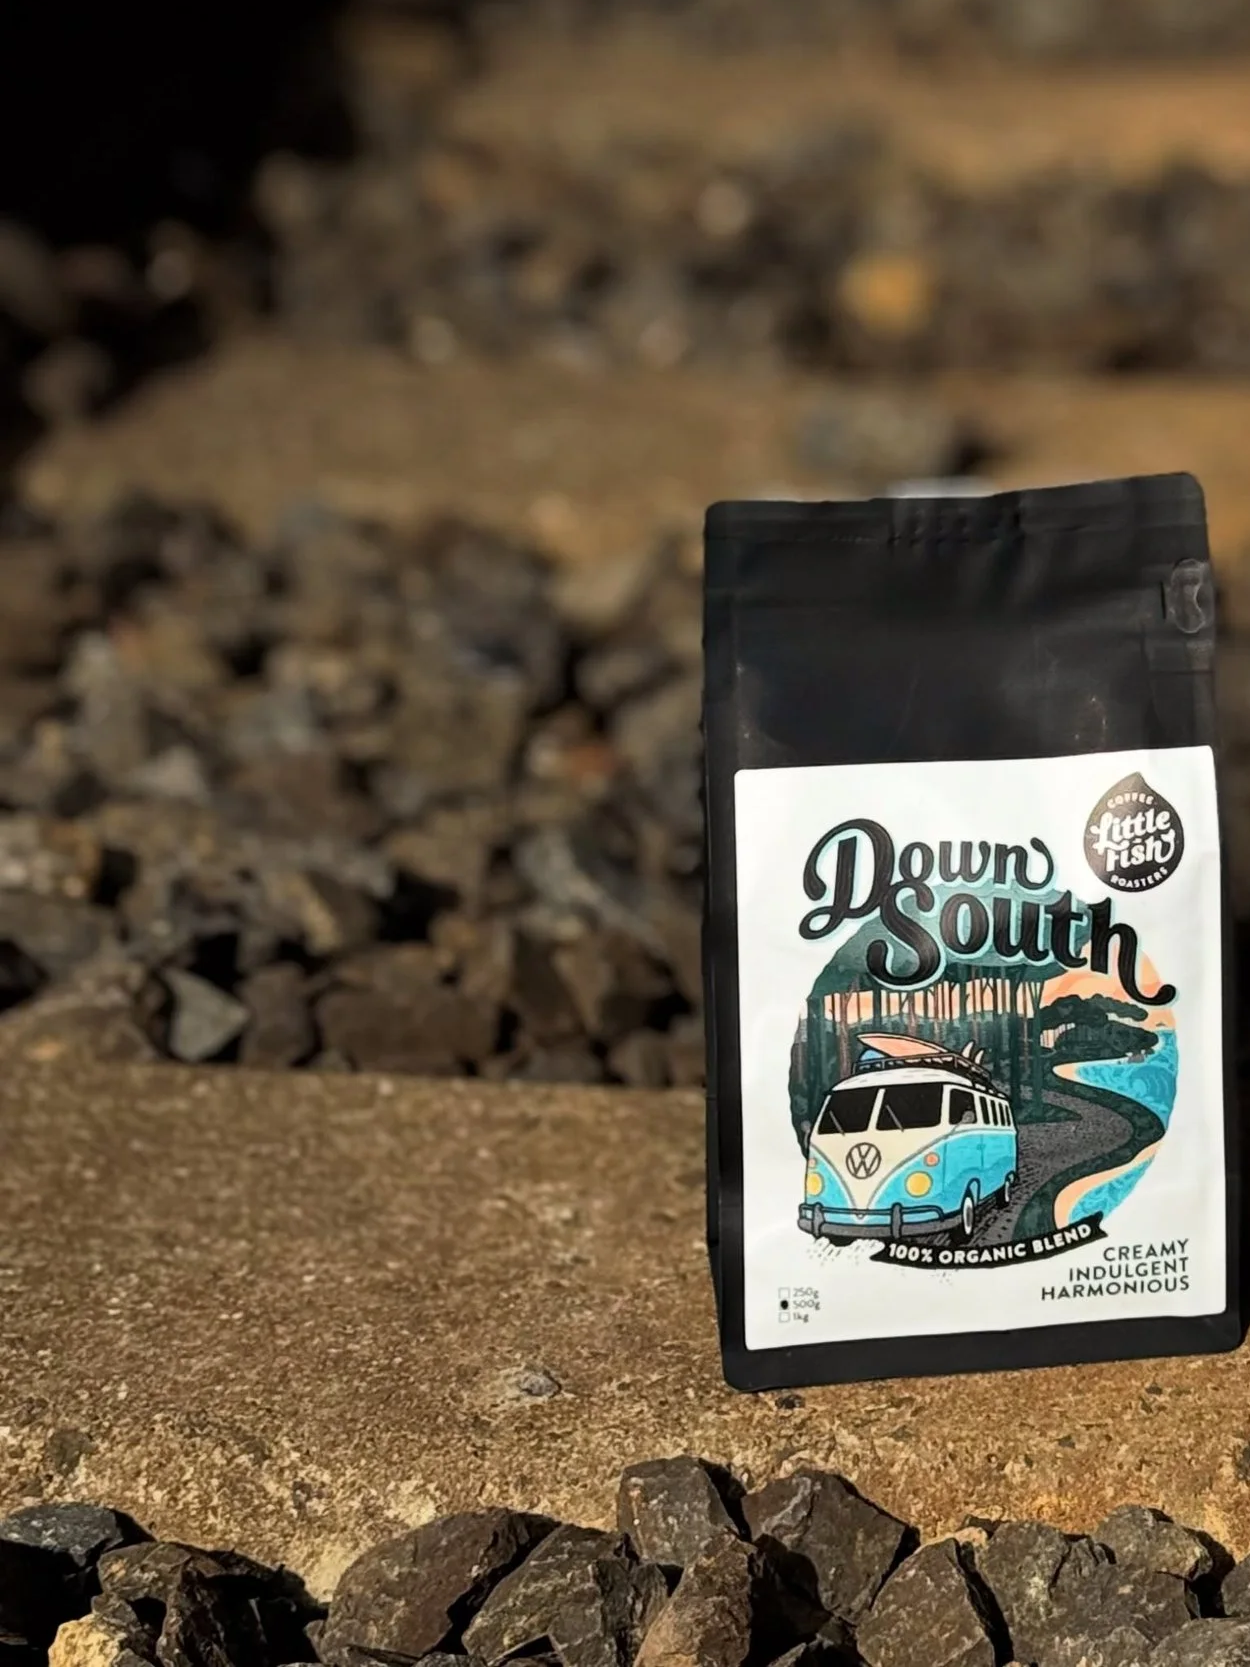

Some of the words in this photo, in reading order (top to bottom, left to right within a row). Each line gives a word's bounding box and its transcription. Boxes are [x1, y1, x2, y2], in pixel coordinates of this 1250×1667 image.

[1107, 792, 1154, 809] COFFEE
[1090, 808, 1171, 855] Little
[1105, 828, 1176, 872] Fish
[799, 818, 1054, 941] Down
[1110, 866, 1168, 888] ROASTERS
[866, 880, 1176, 1006] South
[888, 1242, 933, 1264] 100%
[938, 1245, 1027, 1264] ORGANIC
[1033, 1224, 1092, 1254] BLEND
[1103, 1238, 1189, 1262] CREAMY
[1069, 1257, 1190, 1282] INDULGENT
[1041, 1277, 1190, 1301] HARMONIOUS
